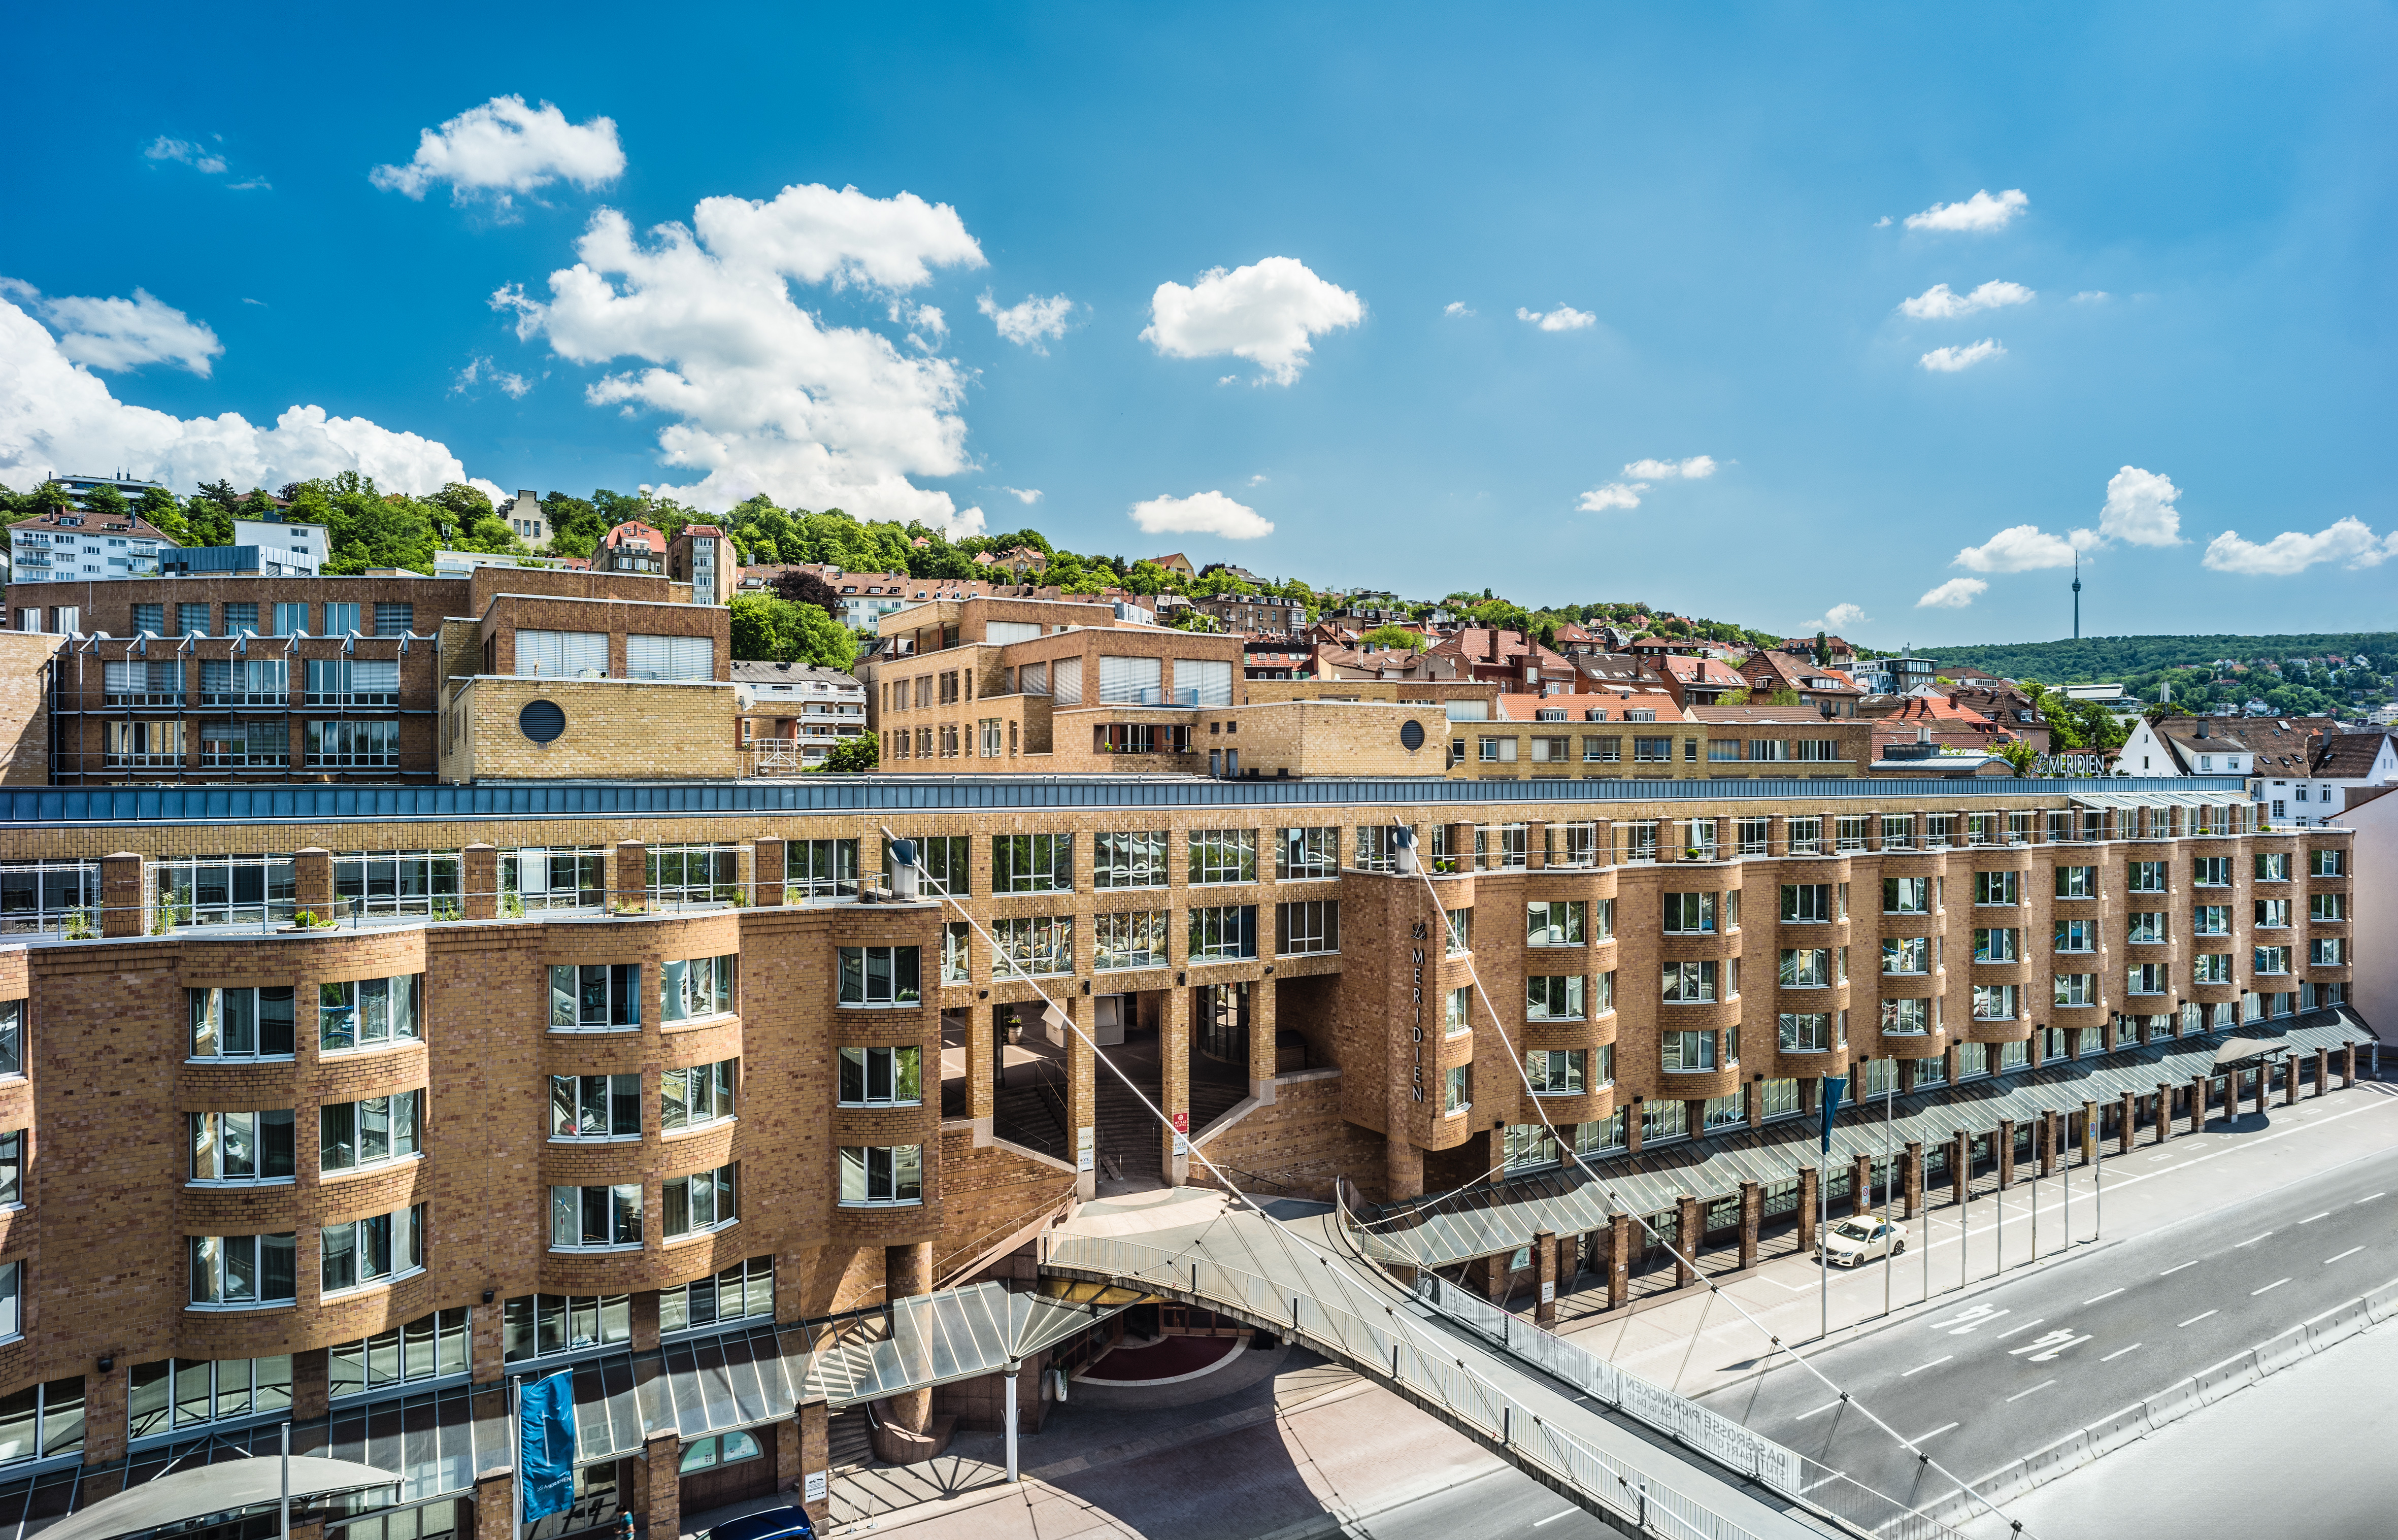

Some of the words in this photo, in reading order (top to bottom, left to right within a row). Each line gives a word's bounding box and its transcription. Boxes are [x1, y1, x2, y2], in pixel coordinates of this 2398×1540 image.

[2031, 754, 2048, 774] Le
[2049, 755, 2104, 774] MERIDIEN
[1411, 923, 1426, 941] Le
[1412, 948, 1424, 1103] MERIDIEN
[544, 1476, 572, 1489] MERIDIEN
